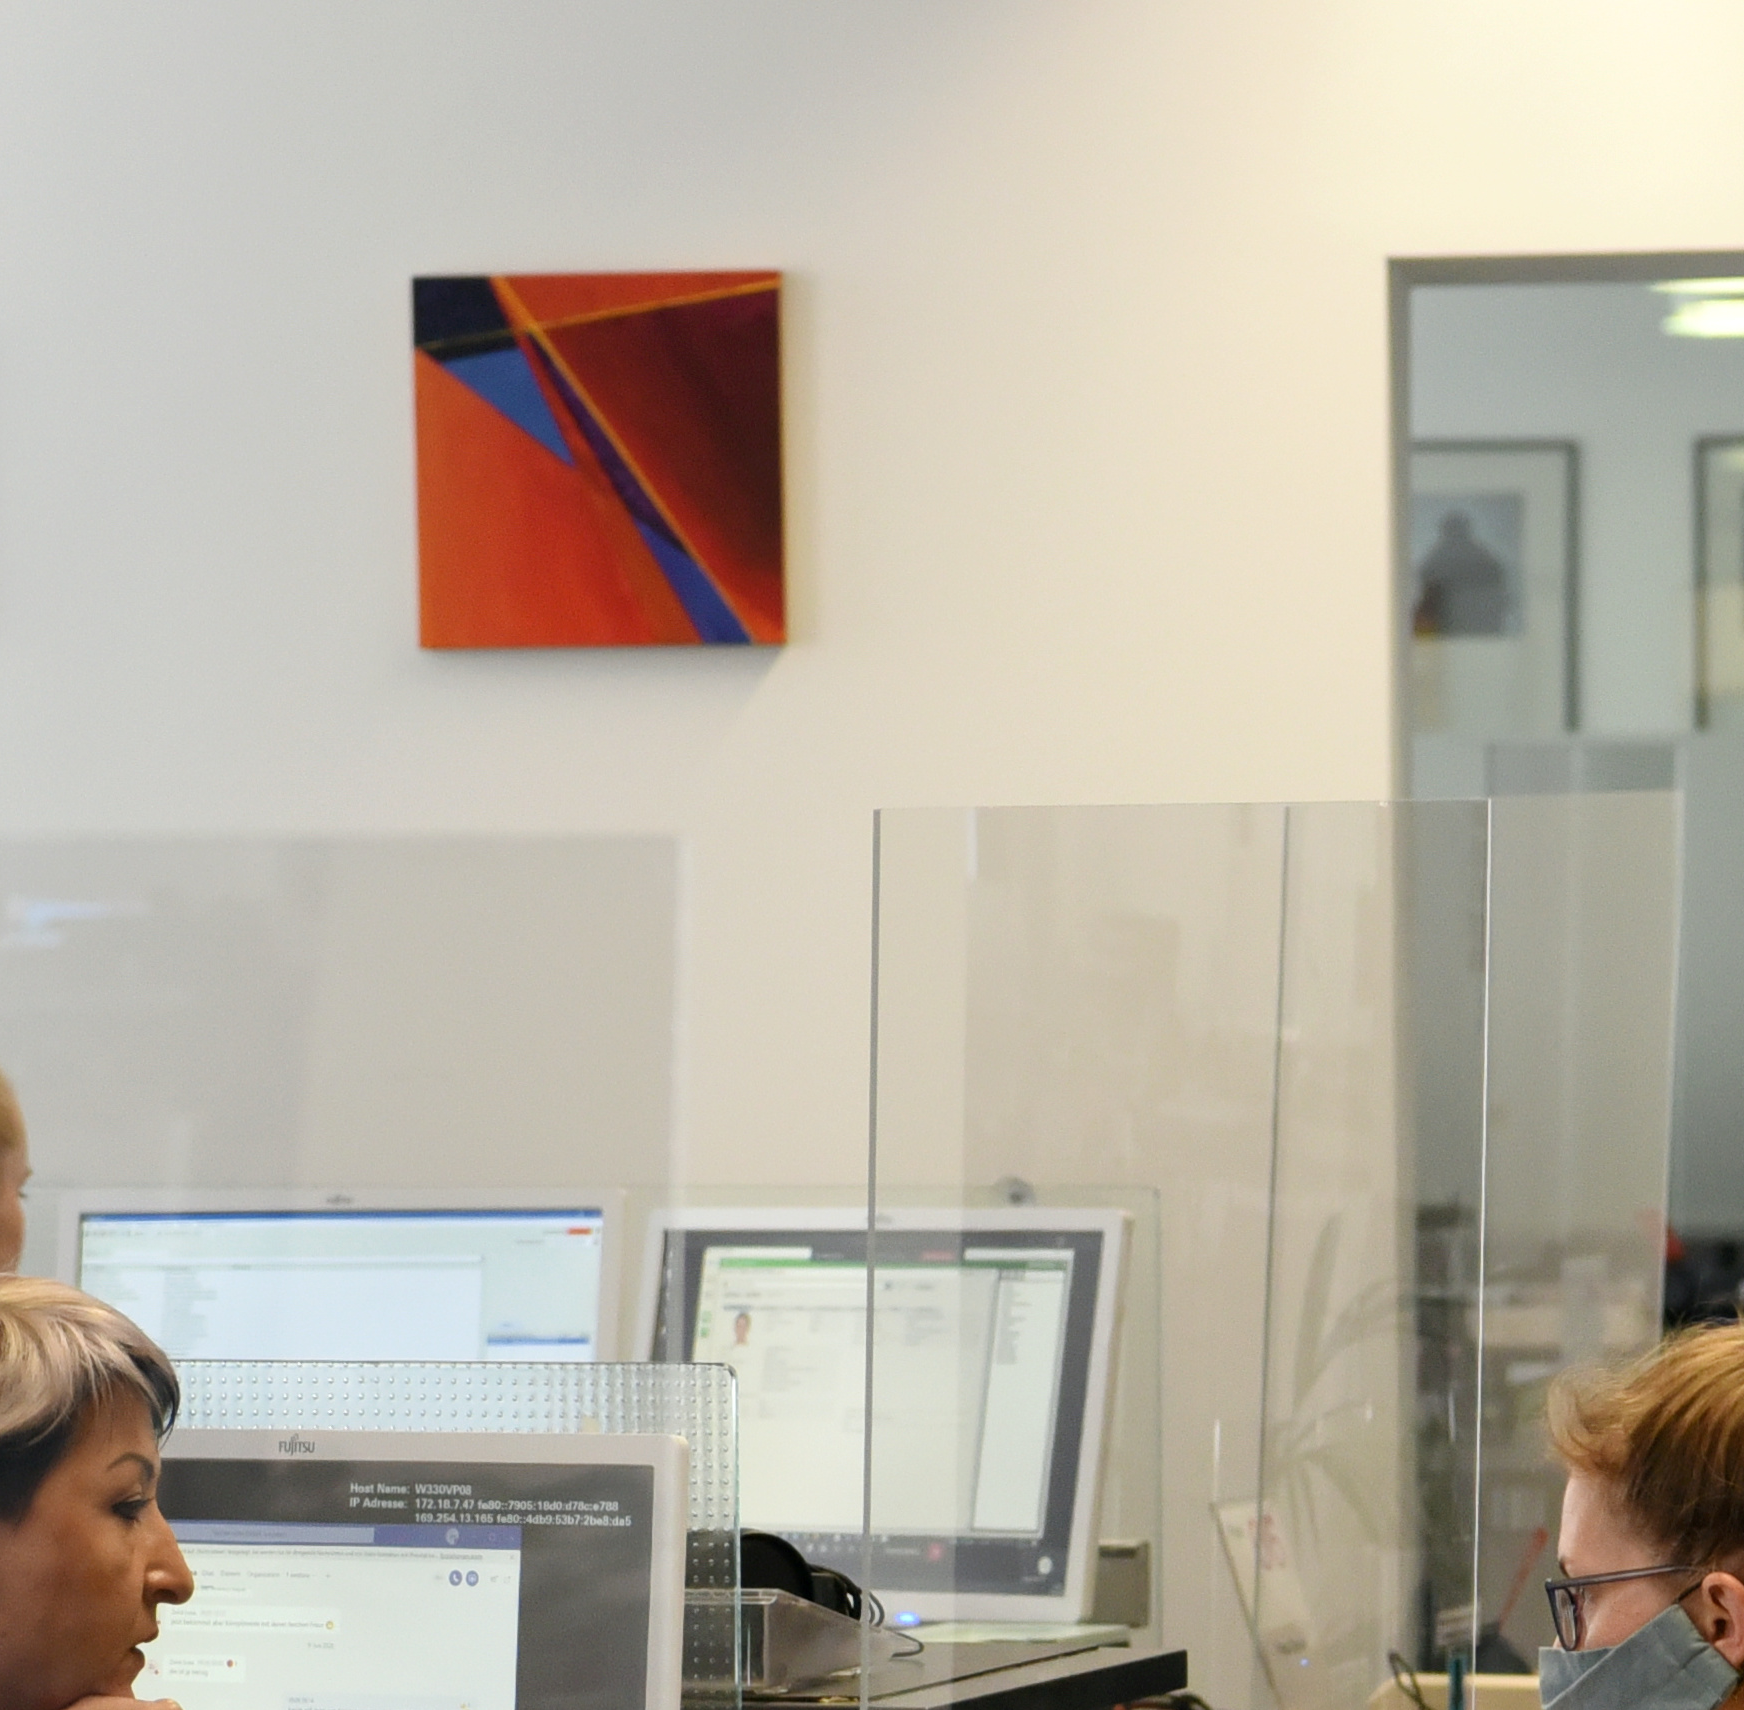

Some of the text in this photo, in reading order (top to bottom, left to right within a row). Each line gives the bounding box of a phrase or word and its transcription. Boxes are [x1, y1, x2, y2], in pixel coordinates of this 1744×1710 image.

[278, 1434, 315, 1455] FUJITSU
[350, 1482, 472, 1497] Host Name: W330VP08
[349, 1497, 361, 1509] IP
[362, 1498, 408, 1510] Adresse:
